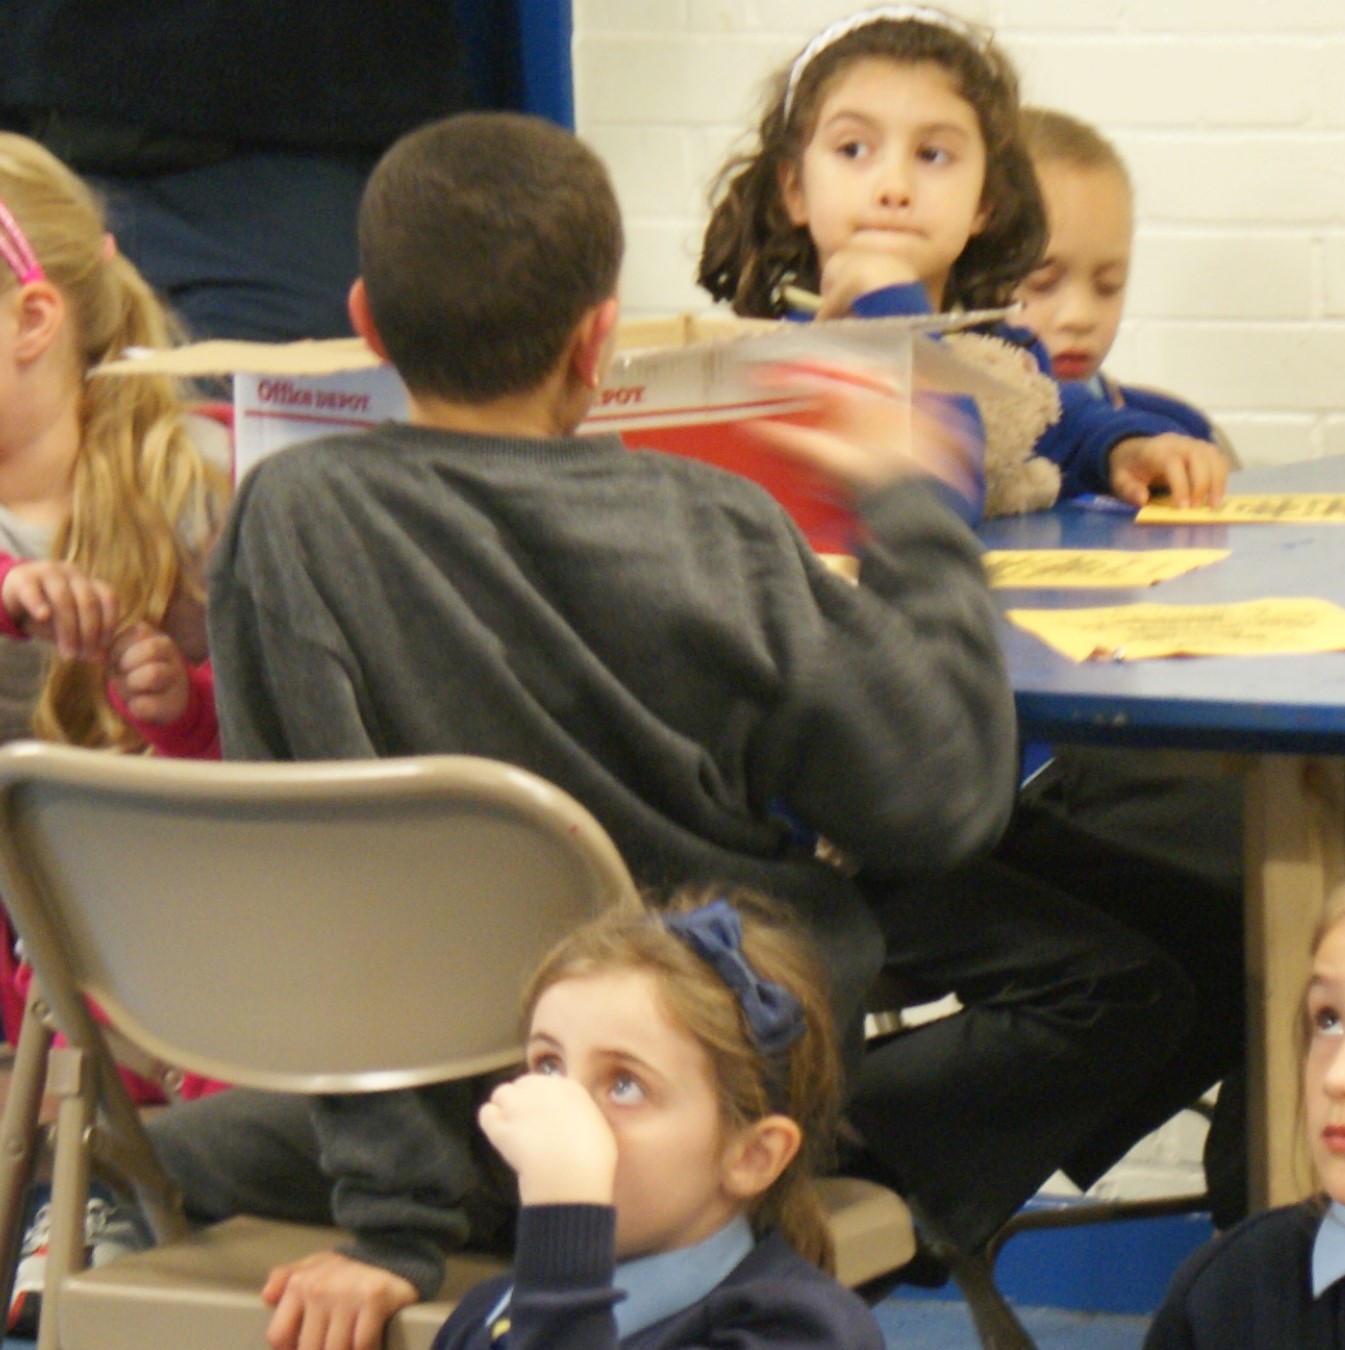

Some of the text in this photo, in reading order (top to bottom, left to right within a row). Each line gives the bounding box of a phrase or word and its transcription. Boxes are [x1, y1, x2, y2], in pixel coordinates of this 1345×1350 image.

[258, 378, 370, 413] Office DEPOT
[601, 384, 646, 405] POT
